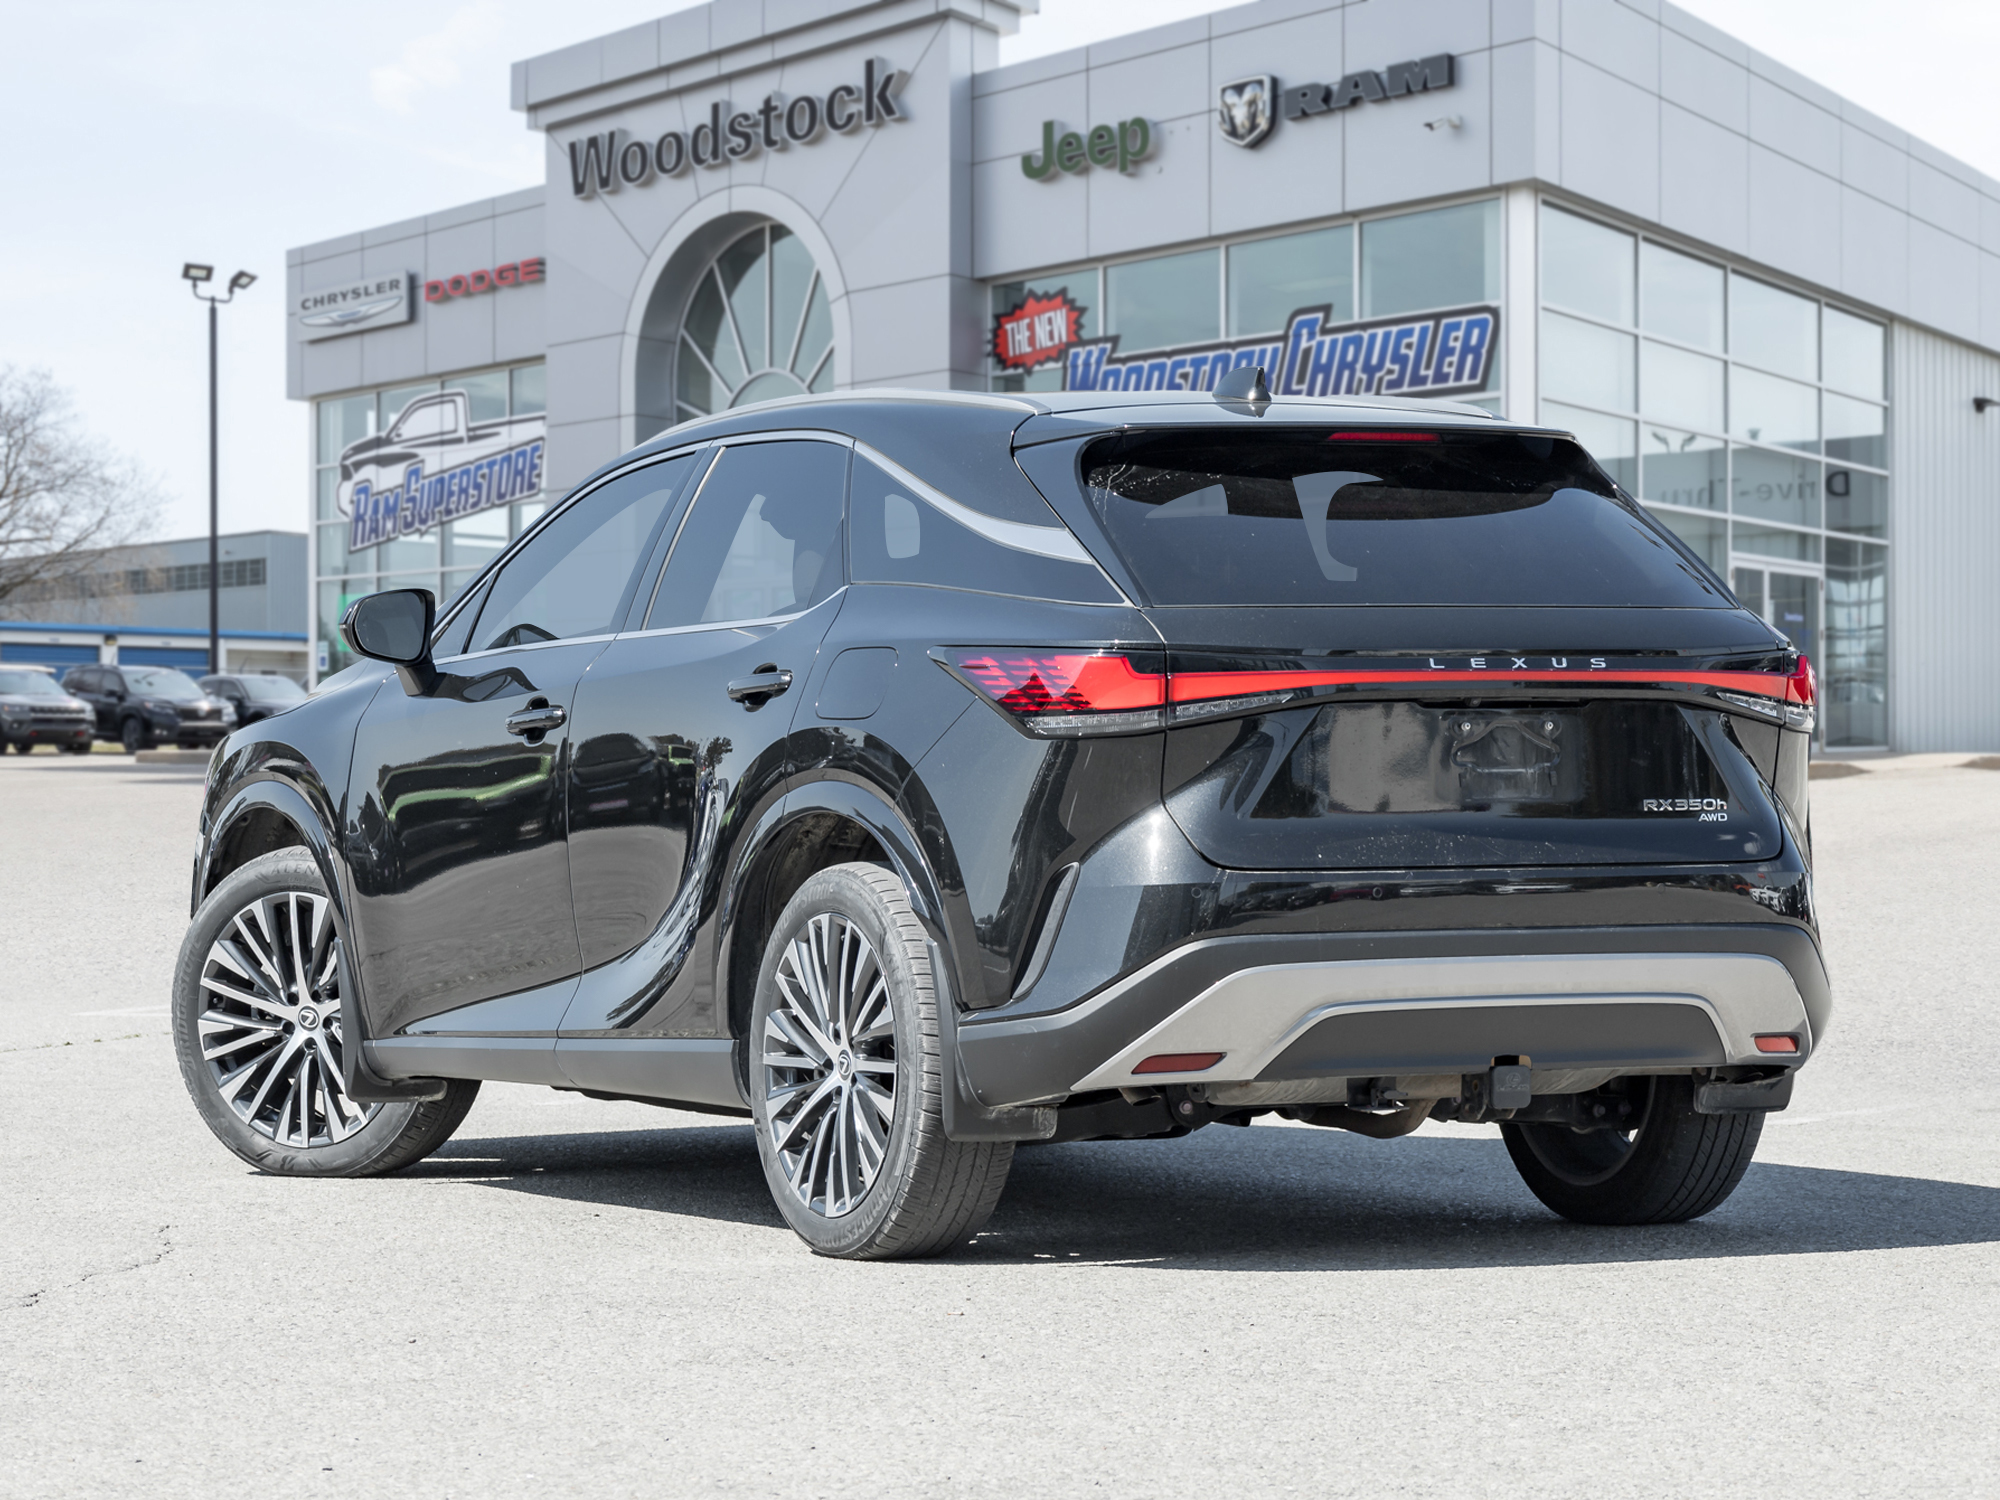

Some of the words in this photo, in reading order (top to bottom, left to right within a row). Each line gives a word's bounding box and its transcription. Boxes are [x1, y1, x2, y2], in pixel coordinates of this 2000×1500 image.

[1284, 53, 1454, 120] RAM
[568, 56, 904, 198] Woodstock
[1021, 116, 1152, 181] Jeep
[301, 278, 402, 312] CHRYSLER
[424, 257, 545, 304] DODGE
[1005, 317, 1033, 358] THE
[1034, 307, 1067, 351] NEW
[1280, 315, 1494, 397] CHRYSLER
[351, 484, 401, 549] RAM
[402, 443, 542, 532] SUPERSTORE
[1428, 656, 1607, 669] LEXUS
[1697, 812, 1728, 822] AWD
